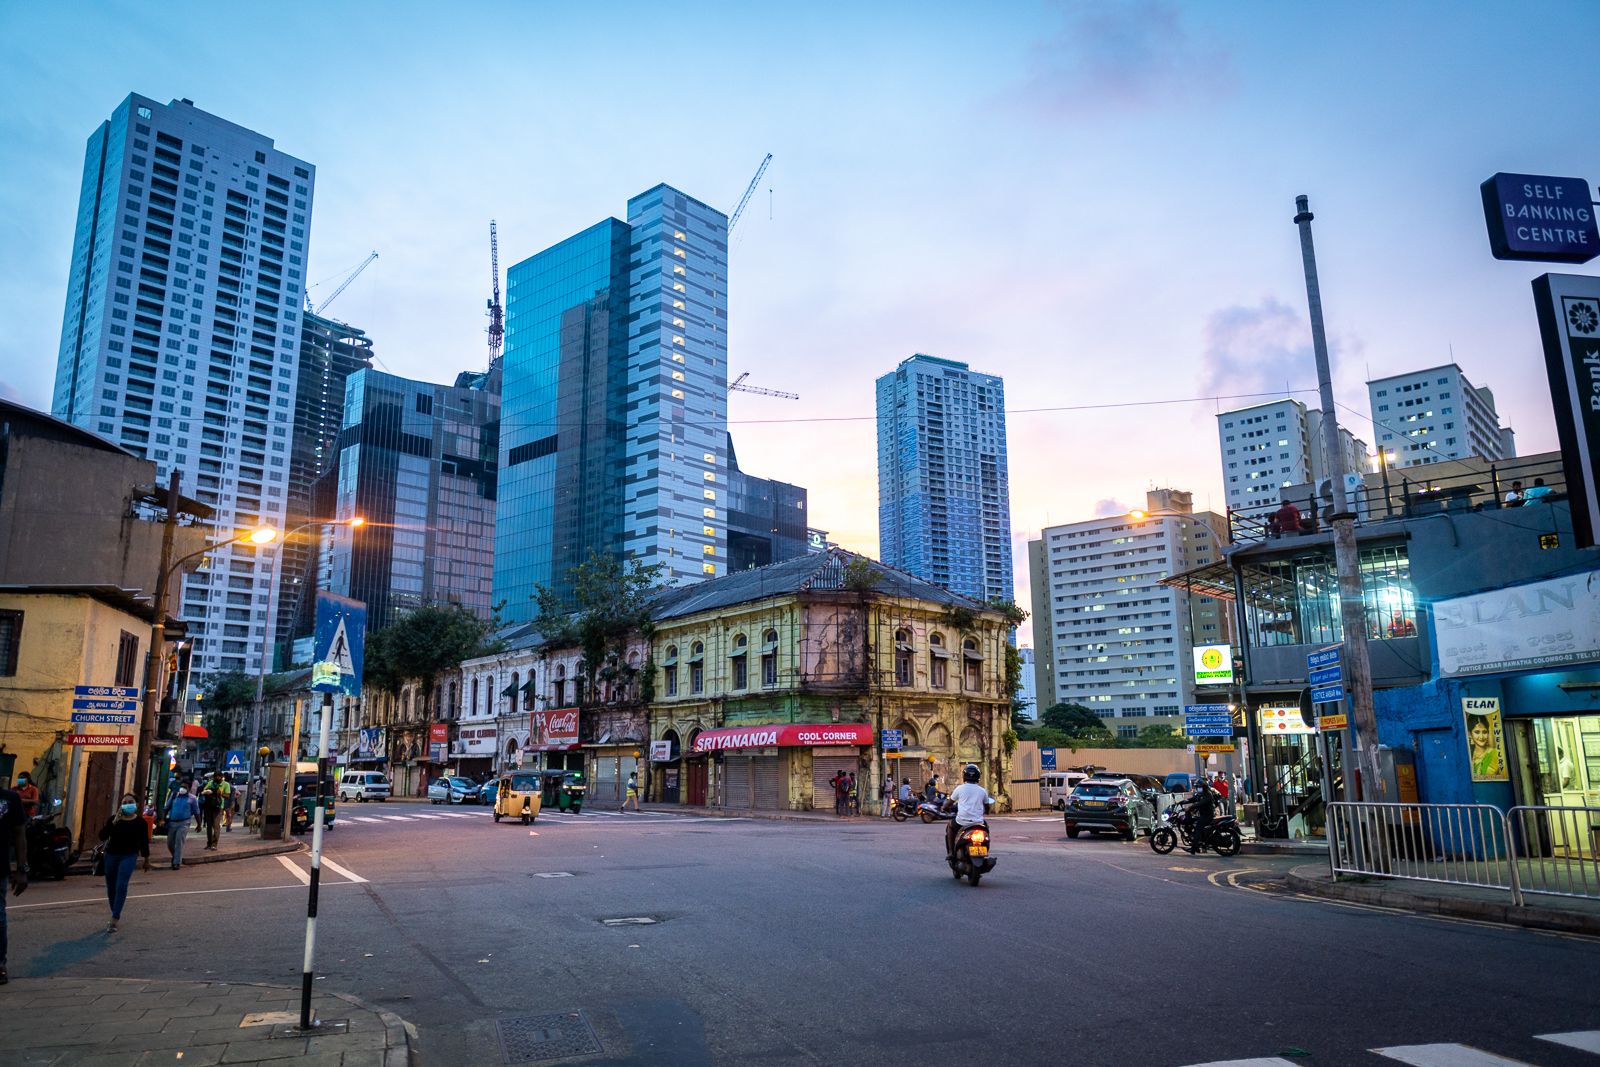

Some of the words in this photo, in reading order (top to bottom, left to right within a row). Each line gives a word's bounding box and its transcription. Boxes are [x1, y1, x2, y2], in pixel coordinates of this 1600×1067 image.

[1523, 184, 1563, 199] SELF
[1505, 203, 1590, 222] BANKING
[1517, 226, 1588, 244] CENTRE
[1459, 665, 1482, 673] JUSTICE
[1483, 662, 1502, 671] AKBAR
[1503, 659, 1532, 668] MAWATHA
[1533, 654, 1573, 664] COLOMBO-02
[1466, 700, 1495, 709] ELAN
[75, 714, 105, 722] CHURCH
[106, 715, 131, 723] STREET
[73, 736, 87, 744] AIA
[88, 736, 129, 745] INSURANCE
[696, 731, 777, 752] SRIYANANDA
[798, 732, 821, 741] COOL
[822, 732, 857, 740] CORNER
[1492, 715, 1504, 772] JEWELLRY
